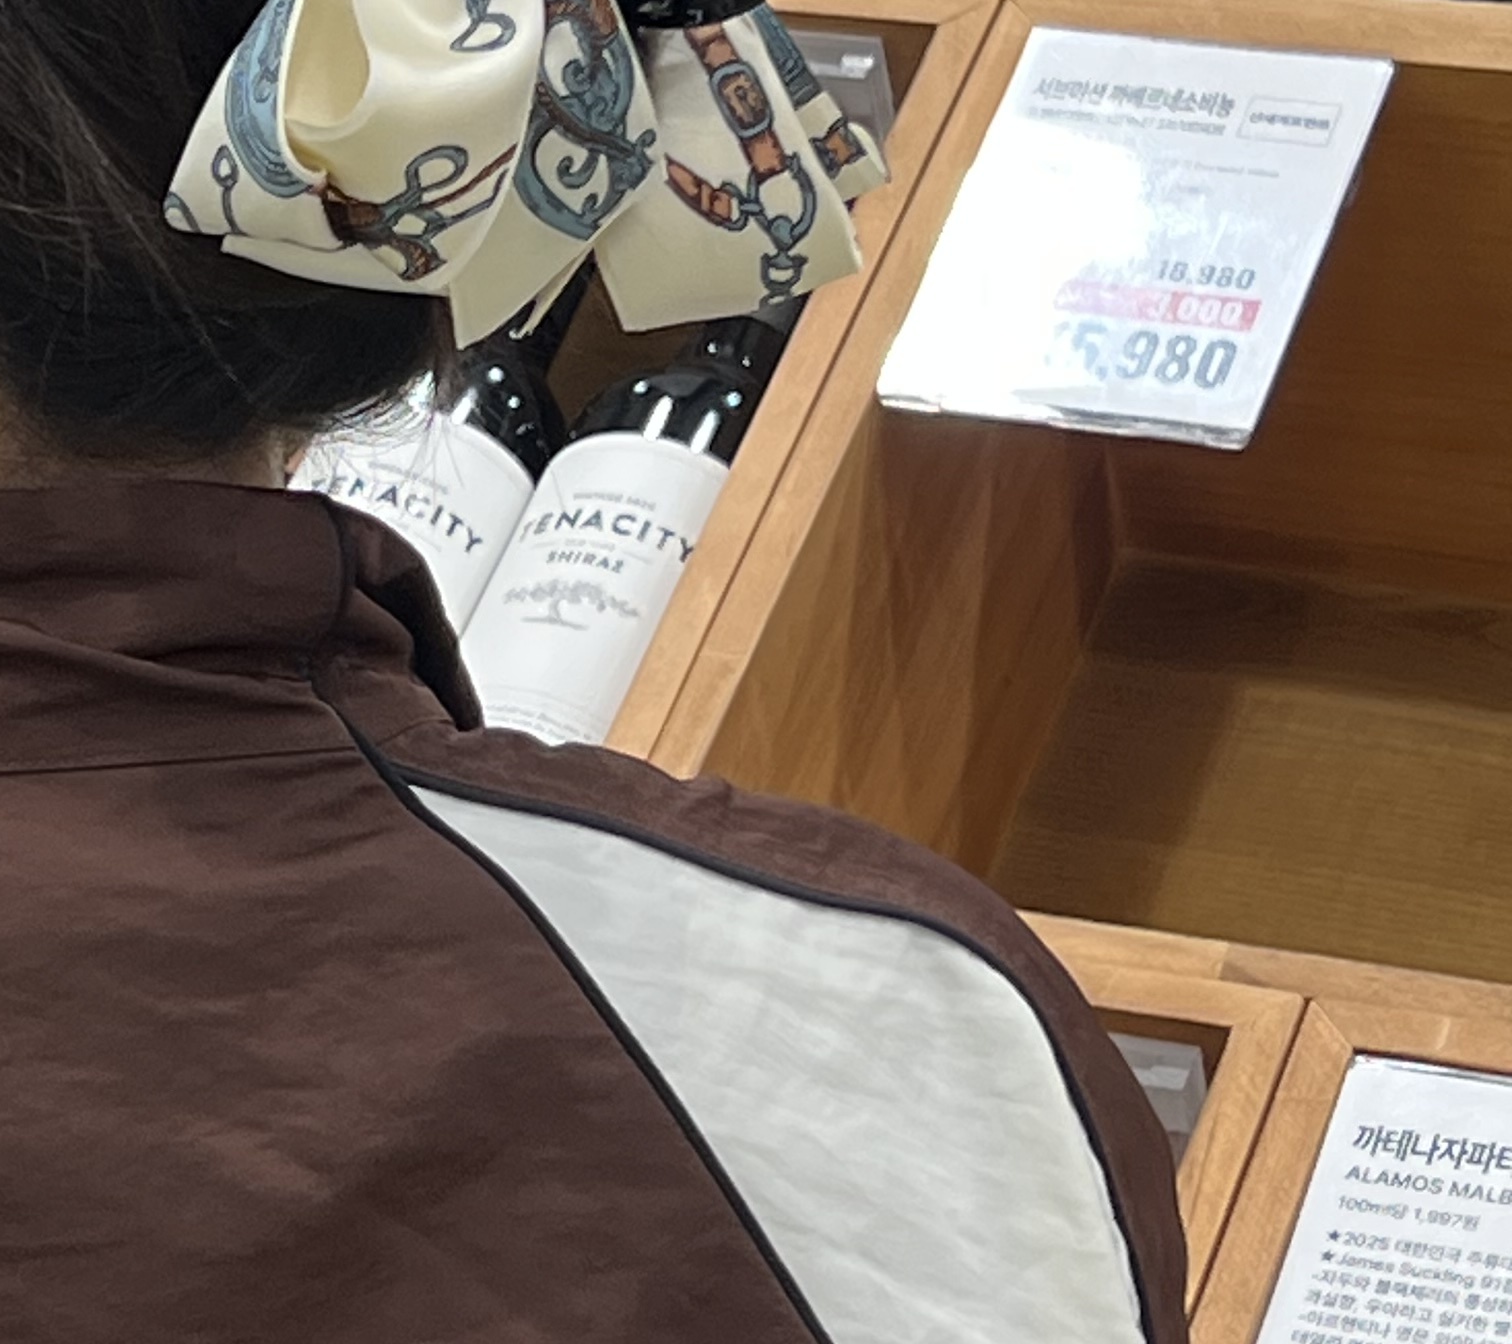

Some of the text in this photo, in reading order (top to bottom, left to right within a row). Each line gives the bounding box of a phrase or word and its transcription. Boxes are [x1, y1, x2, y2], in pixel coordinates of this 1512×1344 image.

[1045, 320, 1238, 389] 5,980
[546, 550, 625, 574] SHIRAZ
[1346, 1165, 1444, 1193] ALAMOS
